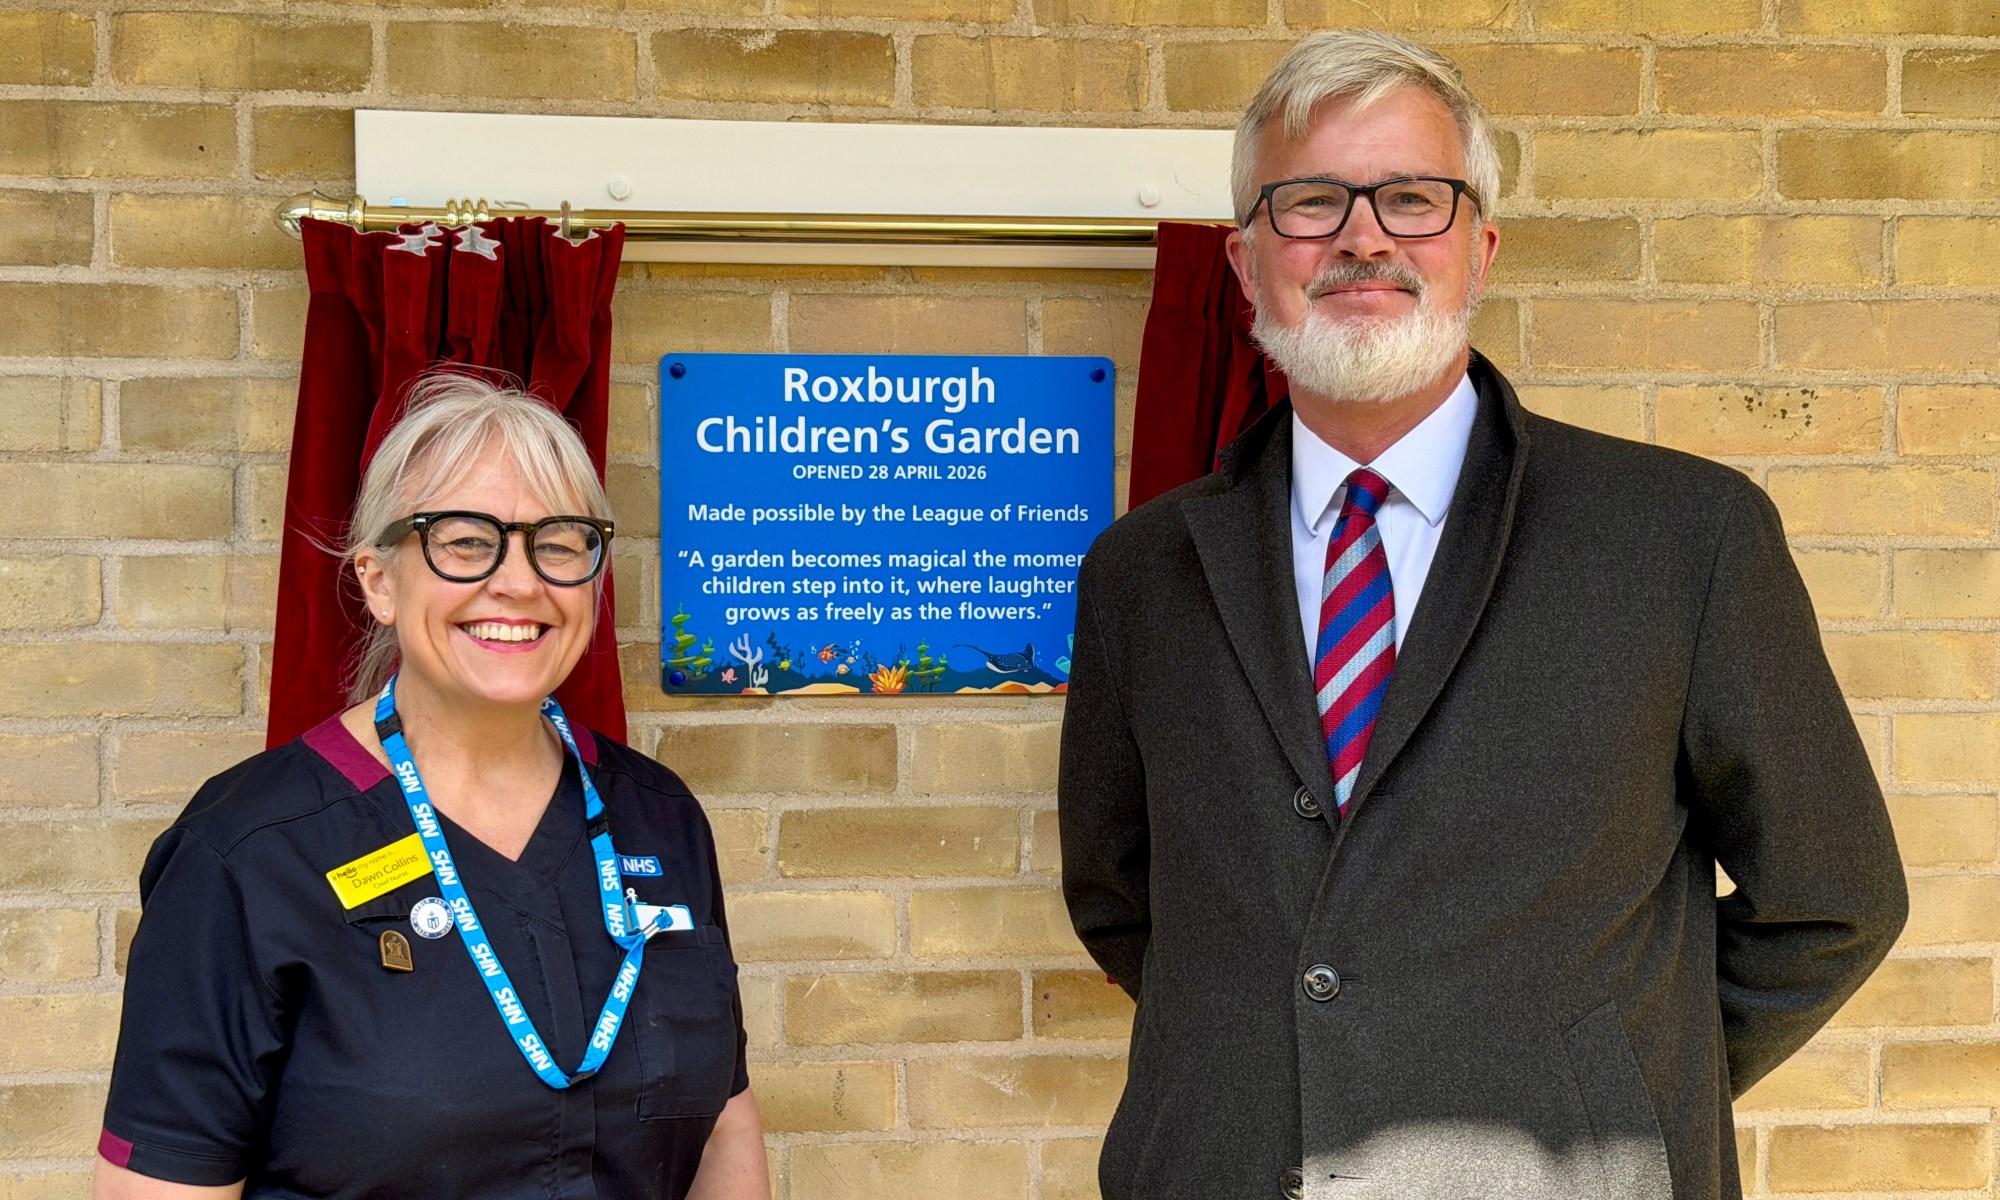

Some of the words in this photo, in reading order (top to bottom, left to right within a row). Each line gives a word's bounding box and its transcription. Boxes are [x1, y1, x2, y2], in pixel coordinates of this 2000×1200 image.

[784, 366, 995, 413] Roxburgh
[696, 416, 910, 454] Children’s
[924, 418, 1080, 454] Garden
[793, 465, 864, 480] OPENED
[868, 465, 889, 480] 28
[894, 465, 942, 480] APRIL
[947, 465, 987, 480] 2026
[688, 504, 746, 522] Made
[752, 503, 835, 526] possible
[842, 503, 866, 526] by
[872, 504, 905, 522] the
[912, 504, 984, 526] League
[990, 503, 1012, 522] of
[1018, 504, 1089, 522] Friends
[679, 550, 705, 568] “A
[711, 550, 784, 573] garden
[791, 550, 882, 568] becomes
[888, 550, 966, 572] magical
[972, 551, 1007, 568] the
[702, 576, 785, 594] children
[792, 578, 837, 599] step
[843, 577, 884, 594] into
[891, 577, 910, 597] it,
[917, 576, 982, 594] where
[989, 576, 1075, 599] laughter
[725, 607, 791, 626] grows
[797, 607, 819, 621] as
[825, 602, 885, 625] freely
[890, 607, 913, 621] as
[918, 603, 953, 620] the
[958, 602, 1052, 620] flowers.”
[396, 761, 422, 793] NHS
[413, 803, 440, 838] NHS
[352, 871, 383, 889] Dawn
[383, 854, 419, 874] Collins
[373, 879, 390, 890] Chief
[389, 870, 408, 883] Nurse
[431, 849, 458, 886] NHS
[600, 859, 620, 892] NHS
[622, 857, 656, 874] NHS
[449, 897, 479, 932] NHS
[606, 903, 626, 938] NHS
[470, 943, 502, 977] NHS
[613, 961, 638, 1003] NHS
[494, 987, 526, 1025] NHS
[593, 1009, 620, 1052] NHS
[519, 1033, 552, 1071] NHS
